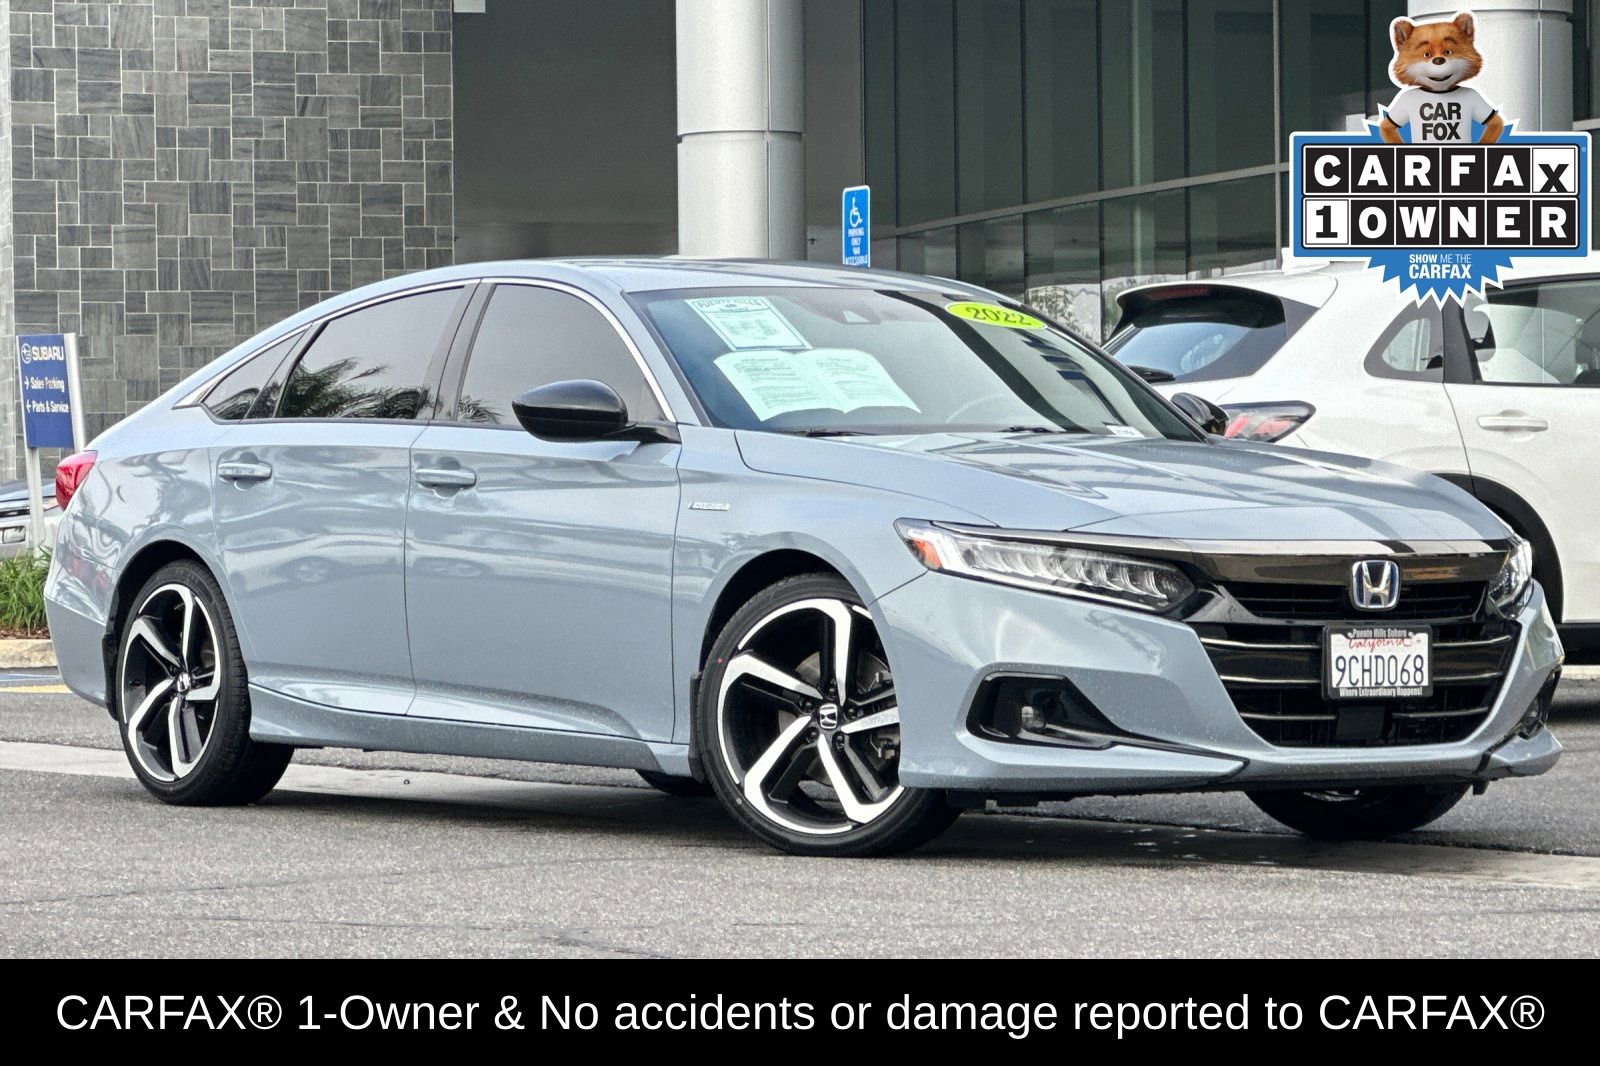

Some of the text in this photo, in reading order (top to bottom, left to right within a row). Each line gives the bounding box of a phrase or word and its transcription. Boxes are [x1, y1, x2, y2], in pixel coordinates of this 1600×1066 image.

[966, 306, 1032, 325] 2022
[32, 345, 64, 361] SUBARU
[30, 376, 65, 392] Sales Parking
[32, 400, 46, 412] Parts
[51, 400, 69, 413] Service
[1335, 654, 1424, 687] 9CHD068
